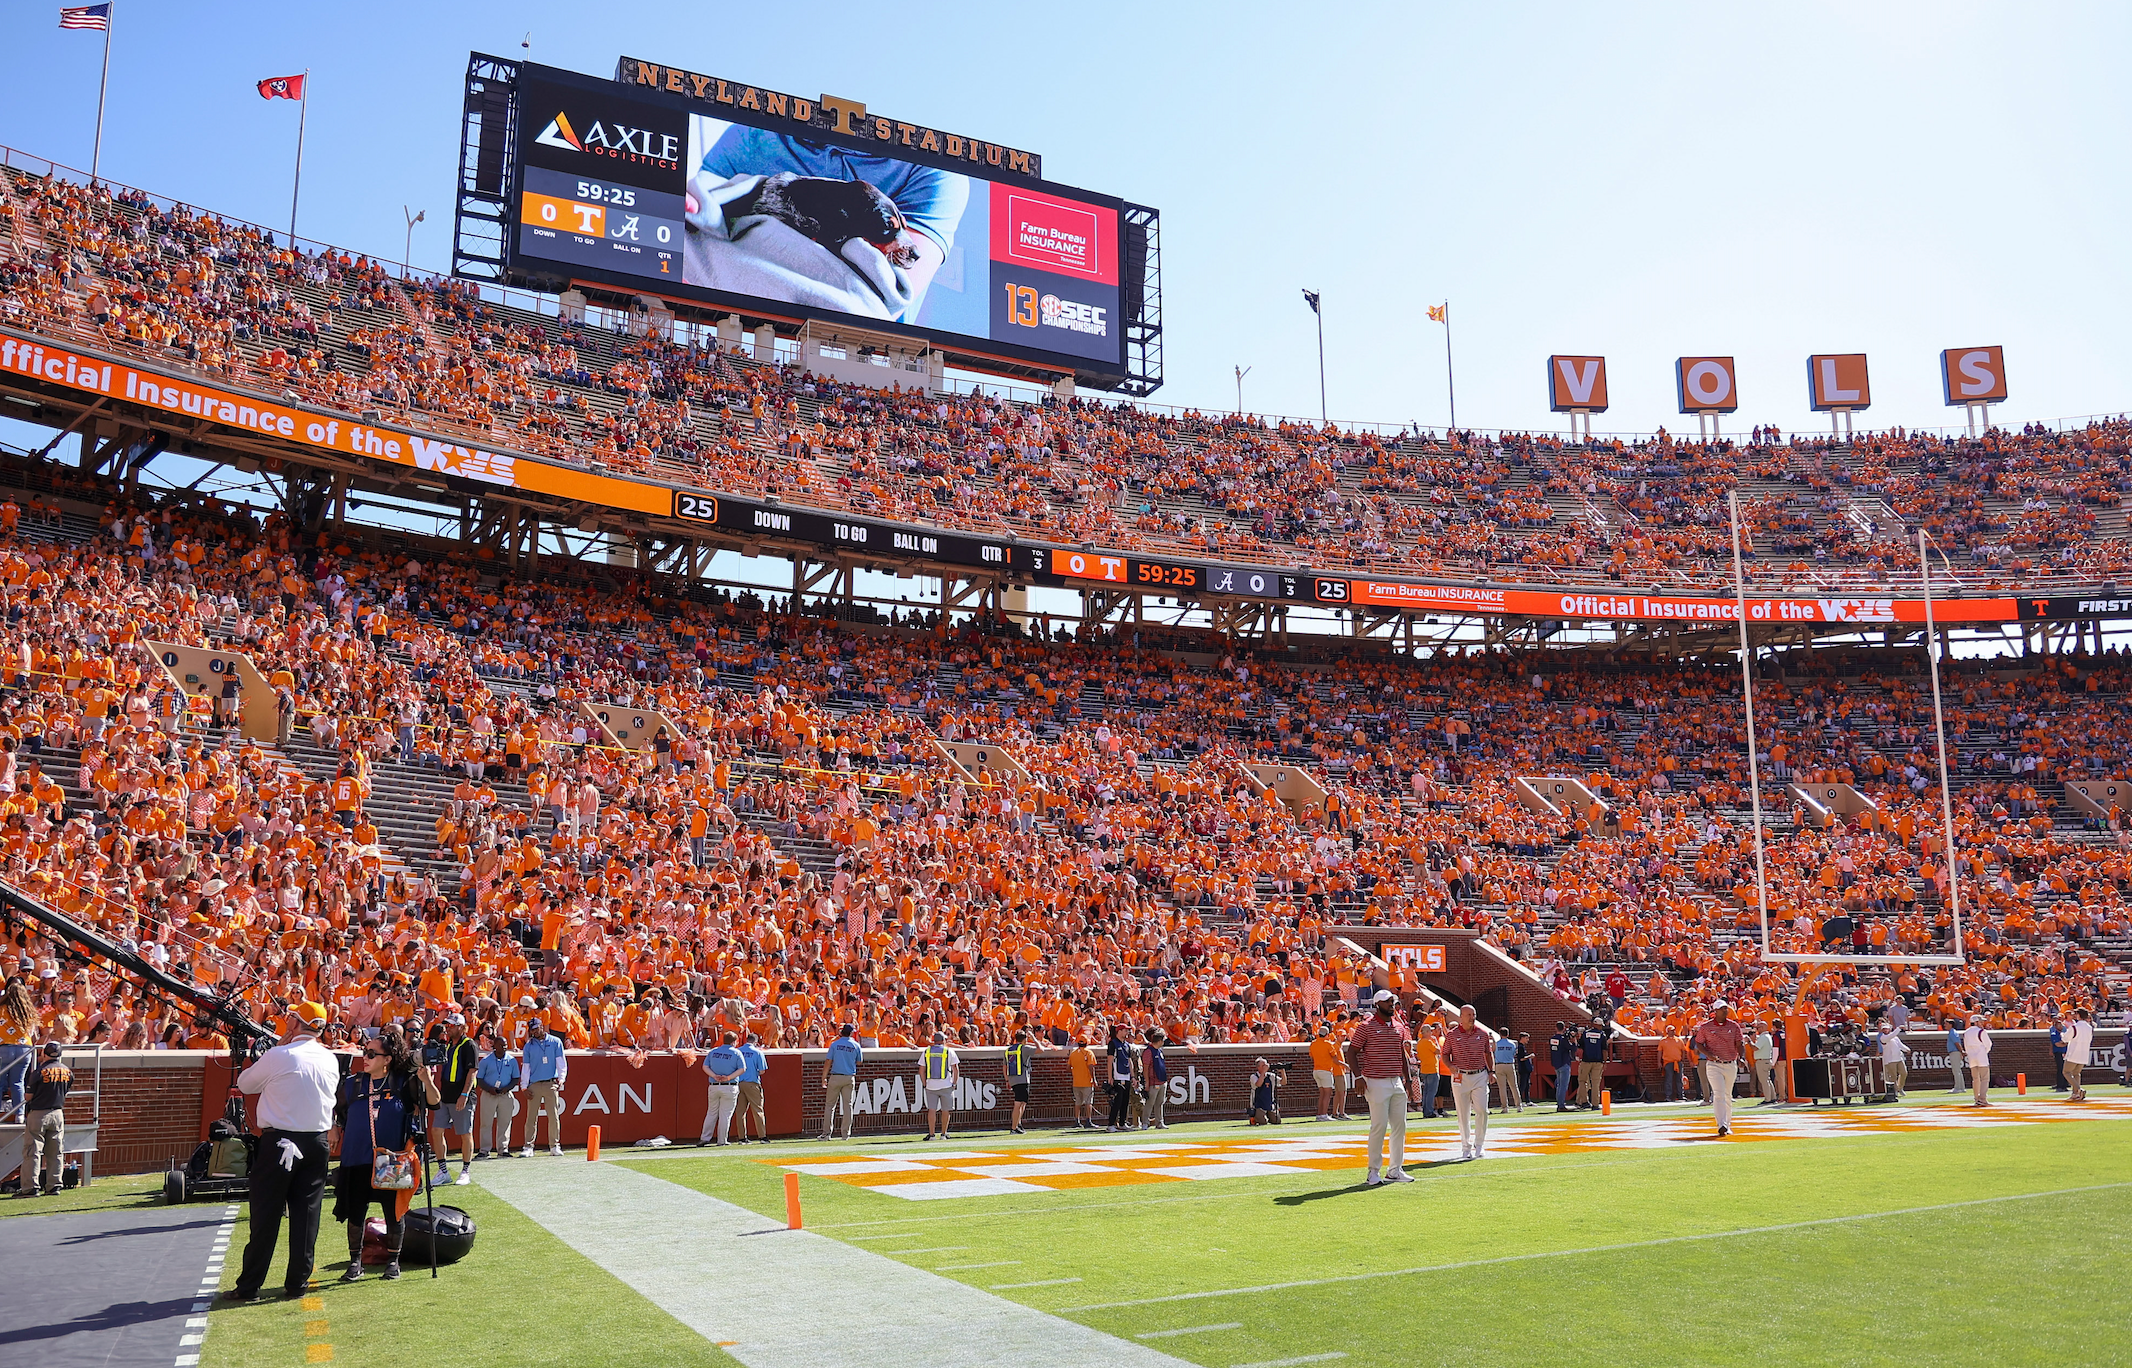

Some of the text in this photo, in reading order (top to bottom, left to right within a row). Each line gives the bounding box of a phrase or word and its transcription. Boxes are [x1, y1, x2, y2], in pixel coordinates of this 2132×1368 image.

[637, 62, 1030, 174] NEYLAND T STADIUM
[583, 120, 679, 162] AXLE
[585, 144, 677, 171] LOGISTICS
[576, 181, 636, 207] 59:25
[541, 203, 557, 222] 0
[573, 204, 601, 233] T
[656, 225, 671, 243] 0
[533, 228, 556, 239] DOWN
[573, 235, 596, 246] TO GO
[1021, 221, 1086, 245] Farm Bureau
[613, 243, 641, 254] BALL ON
[1020, 233, 1086, 256] INSURANCE
[657, 251, 672, 260] QTR
[1060, 256, 1086, 266] Tennessee
[660, 260, 670, 274] 1
[1005, 282, 1039, 328] 13
[1061, 300, 1107, 326] SEC
[1041, 314, 1107, 337] CHAMPIONSHIPS
[0, 340, 112, 392] fficial
[125, 372, 295, 436] Insurance
[306, 420, 339, 446] of
[350, 426, 401, 460] the
[681, 496, 713, 518] 25
[754, 510, 791, 531] DOWN
[833, 523, 867, 543] TO GO
[893, 532, 938, 554] BALL ON
[981, 545, 1012, 564] QTR 1
[1032, 549, 1044, 557] TOL
[1033, 557, 1043, 570] 3
[1069, 555, 1121, 580] 0 T
[1138, 564, 1196, 586] 59:25
[1249, 574, 1265, 593] 0
[1286, 584, 1295, 597] 3
[1319, 581, 1346, 598] 25
[1368, 583, 1504, 602] Farm Bureau INSURANCE
[1477, 604, 1505, 612] Tennessee
[1560, 595, 1635, 616] Official
[1643, 598, 1740, 620] Insurance
[1751, 600, 1772, 619] of
[1779, 600, 1814, 620] the
[2032, 599, 2050, 616] T
[338, 785, 351, 800] 16
[786, 1004, 802, 1021] 16
[514, 1020, 527, 1039] 16
[40, 1067, 71, 1077] EVENT
[43, 1074, 71, 1084] STAFF
